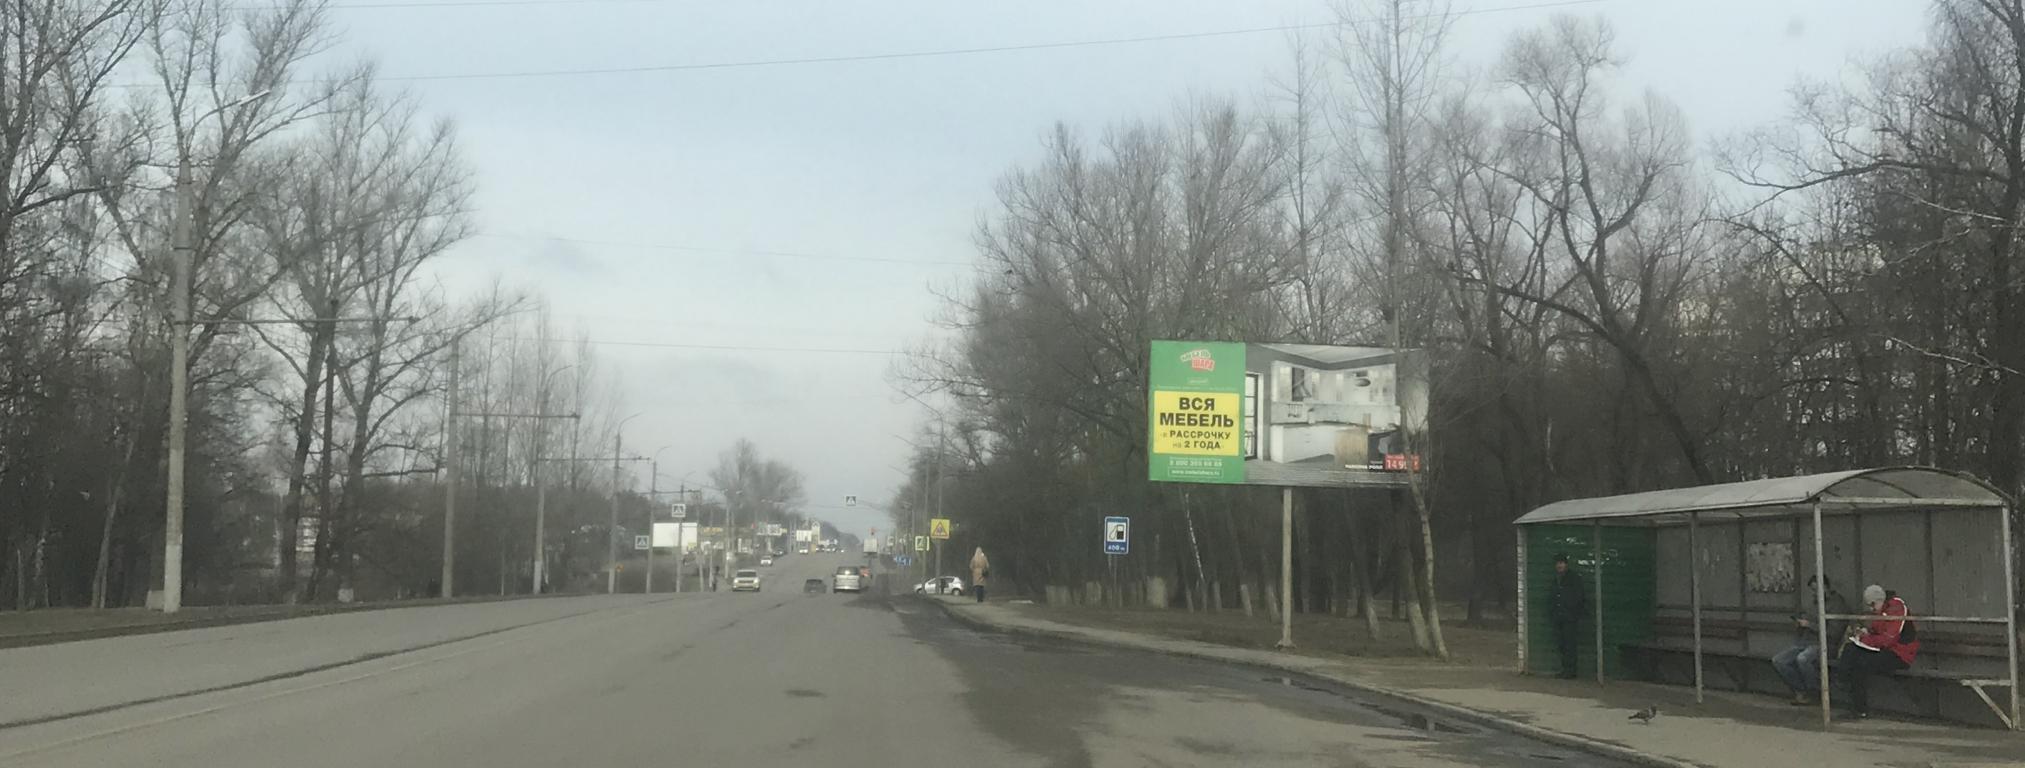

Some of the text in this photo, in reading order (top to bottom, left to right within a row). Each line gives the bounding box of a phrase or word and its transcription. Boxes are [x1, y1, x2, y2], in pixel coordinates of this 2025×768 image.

[1179, 397, 1215, 411] ВСЯ
[1160, 412, 1234, 428] МЕБЕЛЬ
[1170, 430, 1231, 439] РАССРОЧКУ
[1194, 441, 1221, 449] ГОДА
